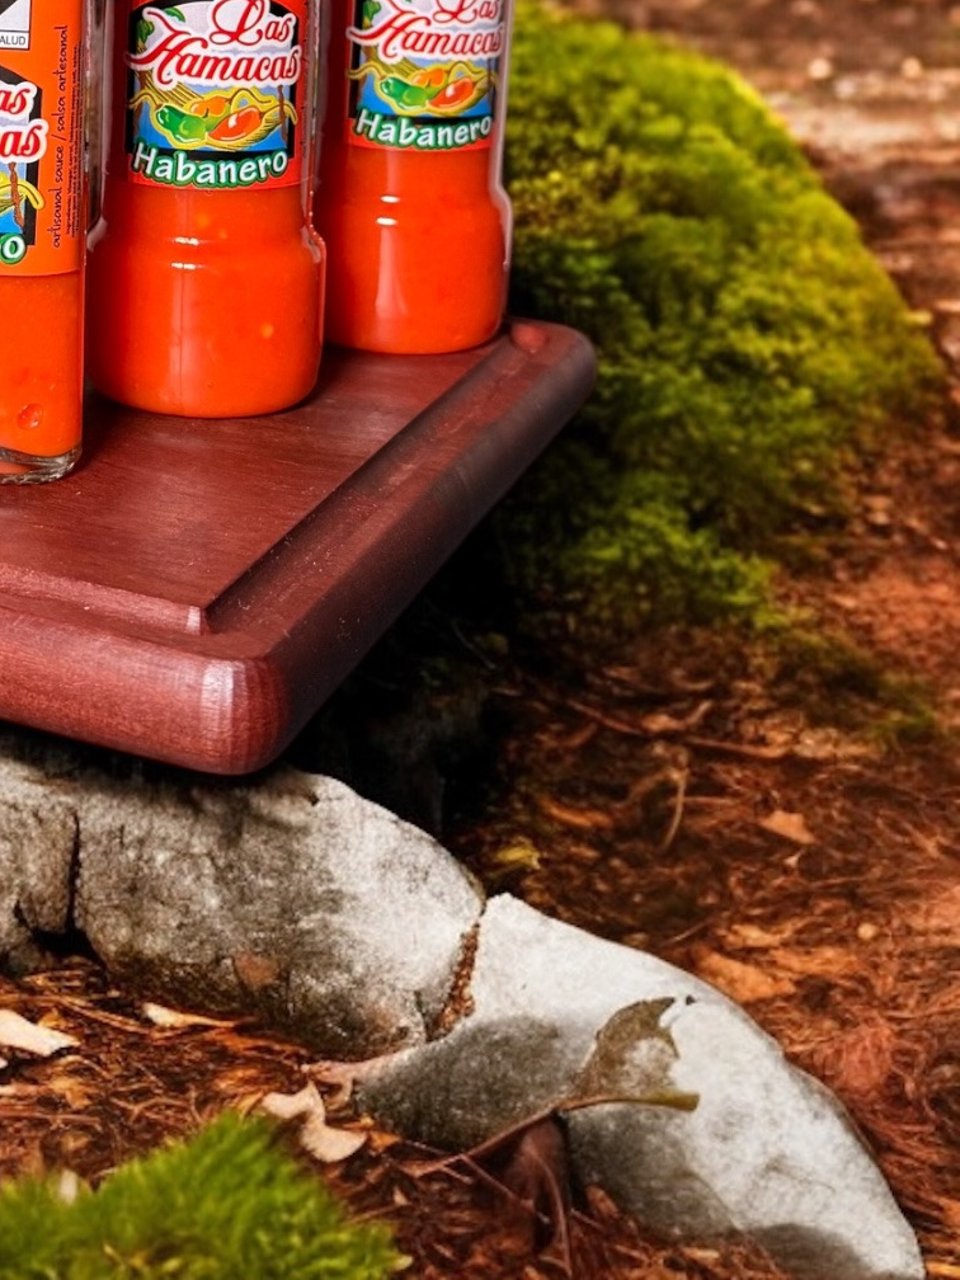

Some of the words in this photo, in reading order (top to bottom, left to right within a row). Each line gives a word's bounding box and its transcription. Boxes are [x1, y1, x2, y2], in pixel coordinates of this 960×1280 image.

[52, 25, 68, 91] artesanal
[126, 11, 301, 84] Hamacas
[51, 96, 66, 132] salsa
[356, 108, 492, 147] Habanero
[55, 145, 64, 183] sauce
[133, 141, 288, 184] Habanero
[47, 188, 62, 248] artisanal
